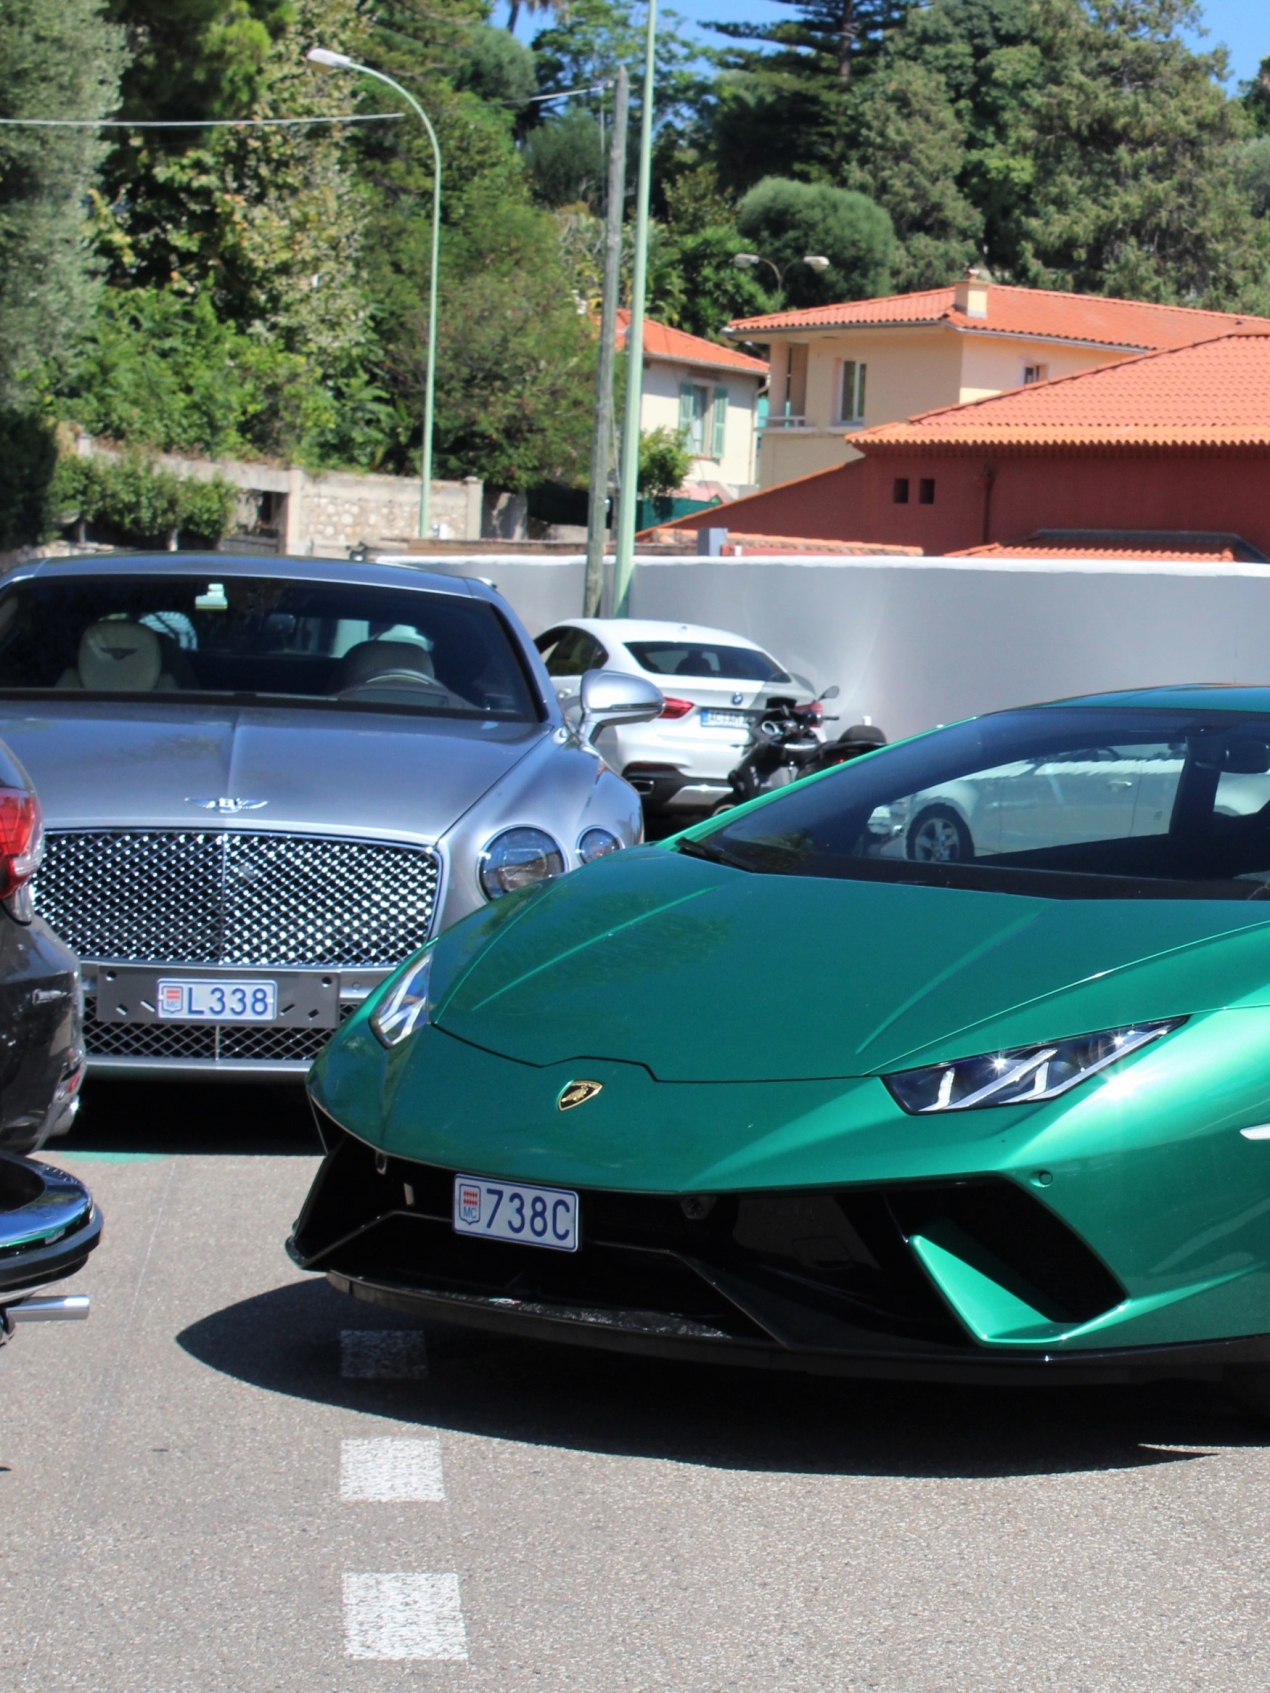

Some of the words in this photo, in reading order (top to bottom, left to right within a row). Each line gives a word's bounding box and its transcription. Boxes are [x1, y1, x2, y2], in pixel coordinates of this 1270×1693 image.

[187, 987, 268, 1015] L338
[463, 1206, 477, 1220] MC
[486, 1188, 571, 1241] 738C
